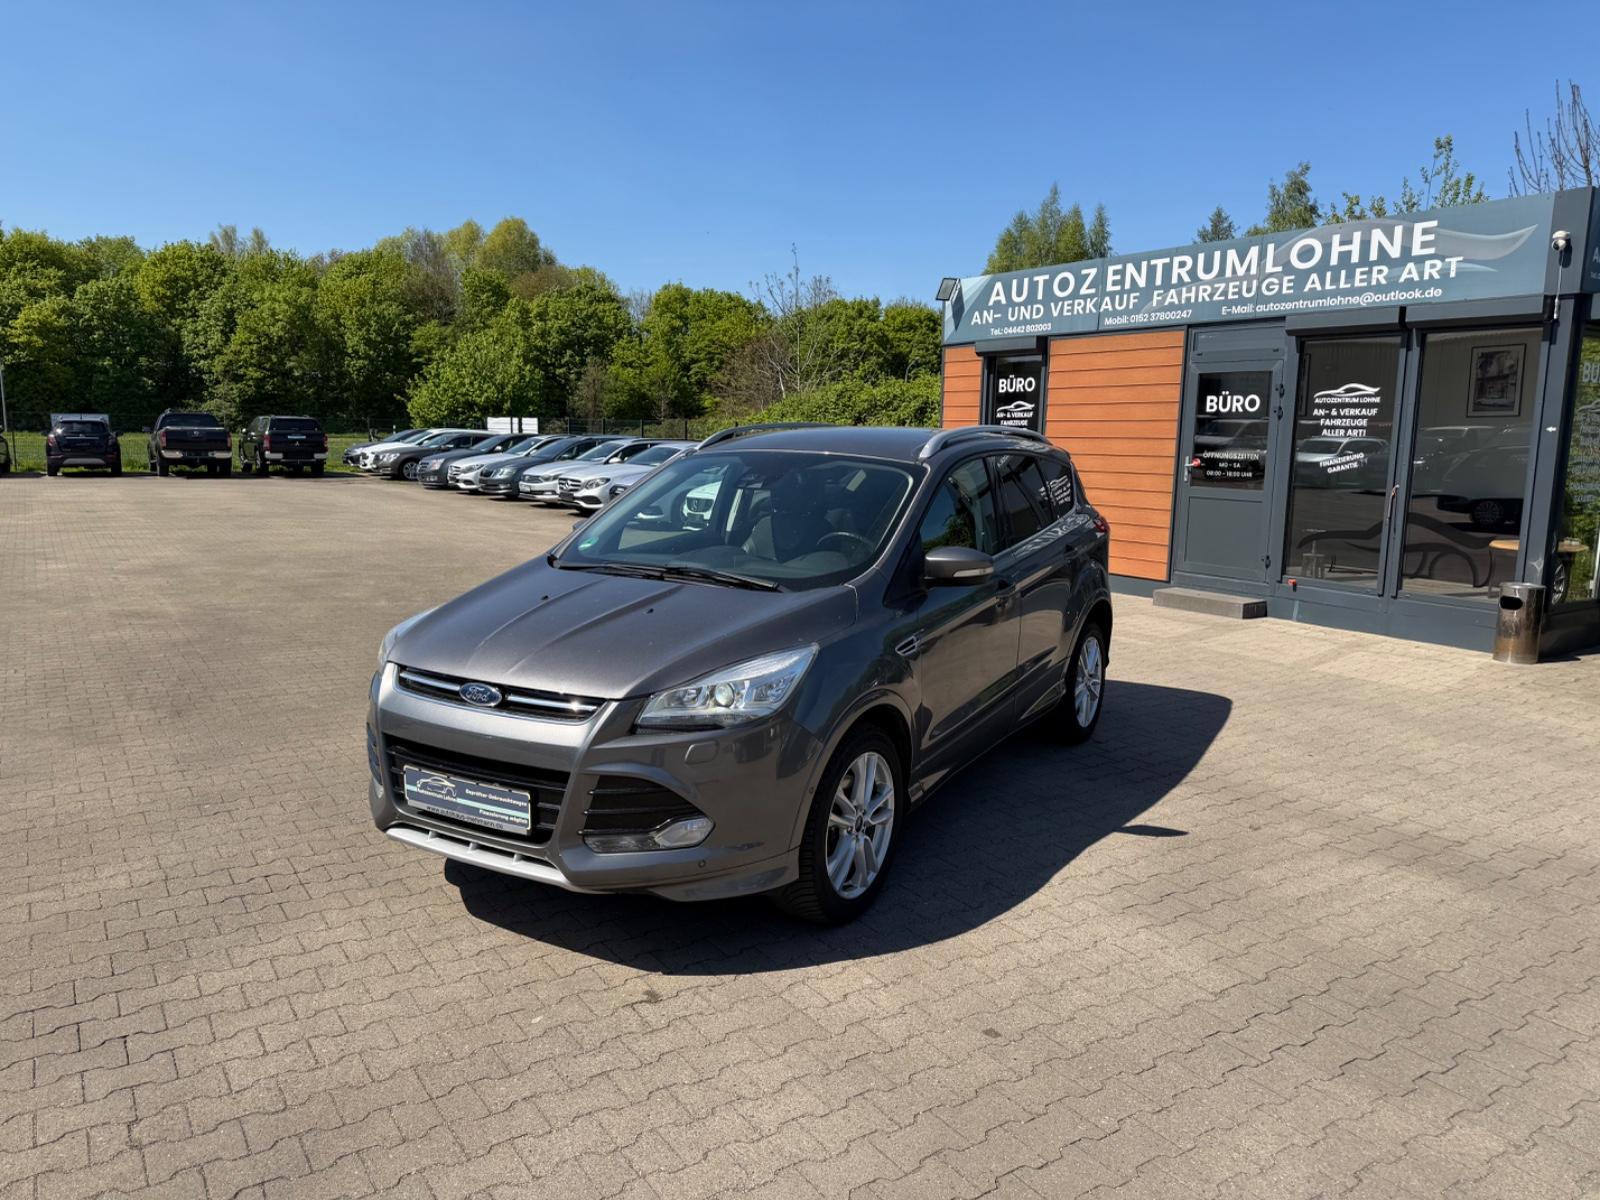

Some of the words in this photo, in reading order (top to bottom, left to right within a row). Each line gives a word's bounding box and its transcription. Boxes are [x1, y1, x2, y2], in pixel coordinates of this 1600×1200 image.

[970, 310, 1002, 326] AN-
[1008, 304, 1044, 321] UND
[1050, 293, 1140, 318] VERKAUF
[1152, 275, 1295, 307] FAHRZEUGE
[1304, 265, 1389, 292] ALLER
[1399, 256, 1464, 283] ART
[1104, 315, 1129, 326] Mobil:
[1130, 313, 1149, 323] 0152
[1150, 309, 1193, 321] 37800247
[998, 374, 1036, 393] BÜRO
[1205, 391, 1261, 413] BÜRO
[1312, 408, 1330, 416] AN-
[1330, 408, 1338, 416] &
[1339, 407, 1379, 417] VERKAUF
[1320, 418, 1369, 427] FAHRZEUGE
[1321, 428, 1346, 437] ALLER
[465, 685, 491, 703] Ford
